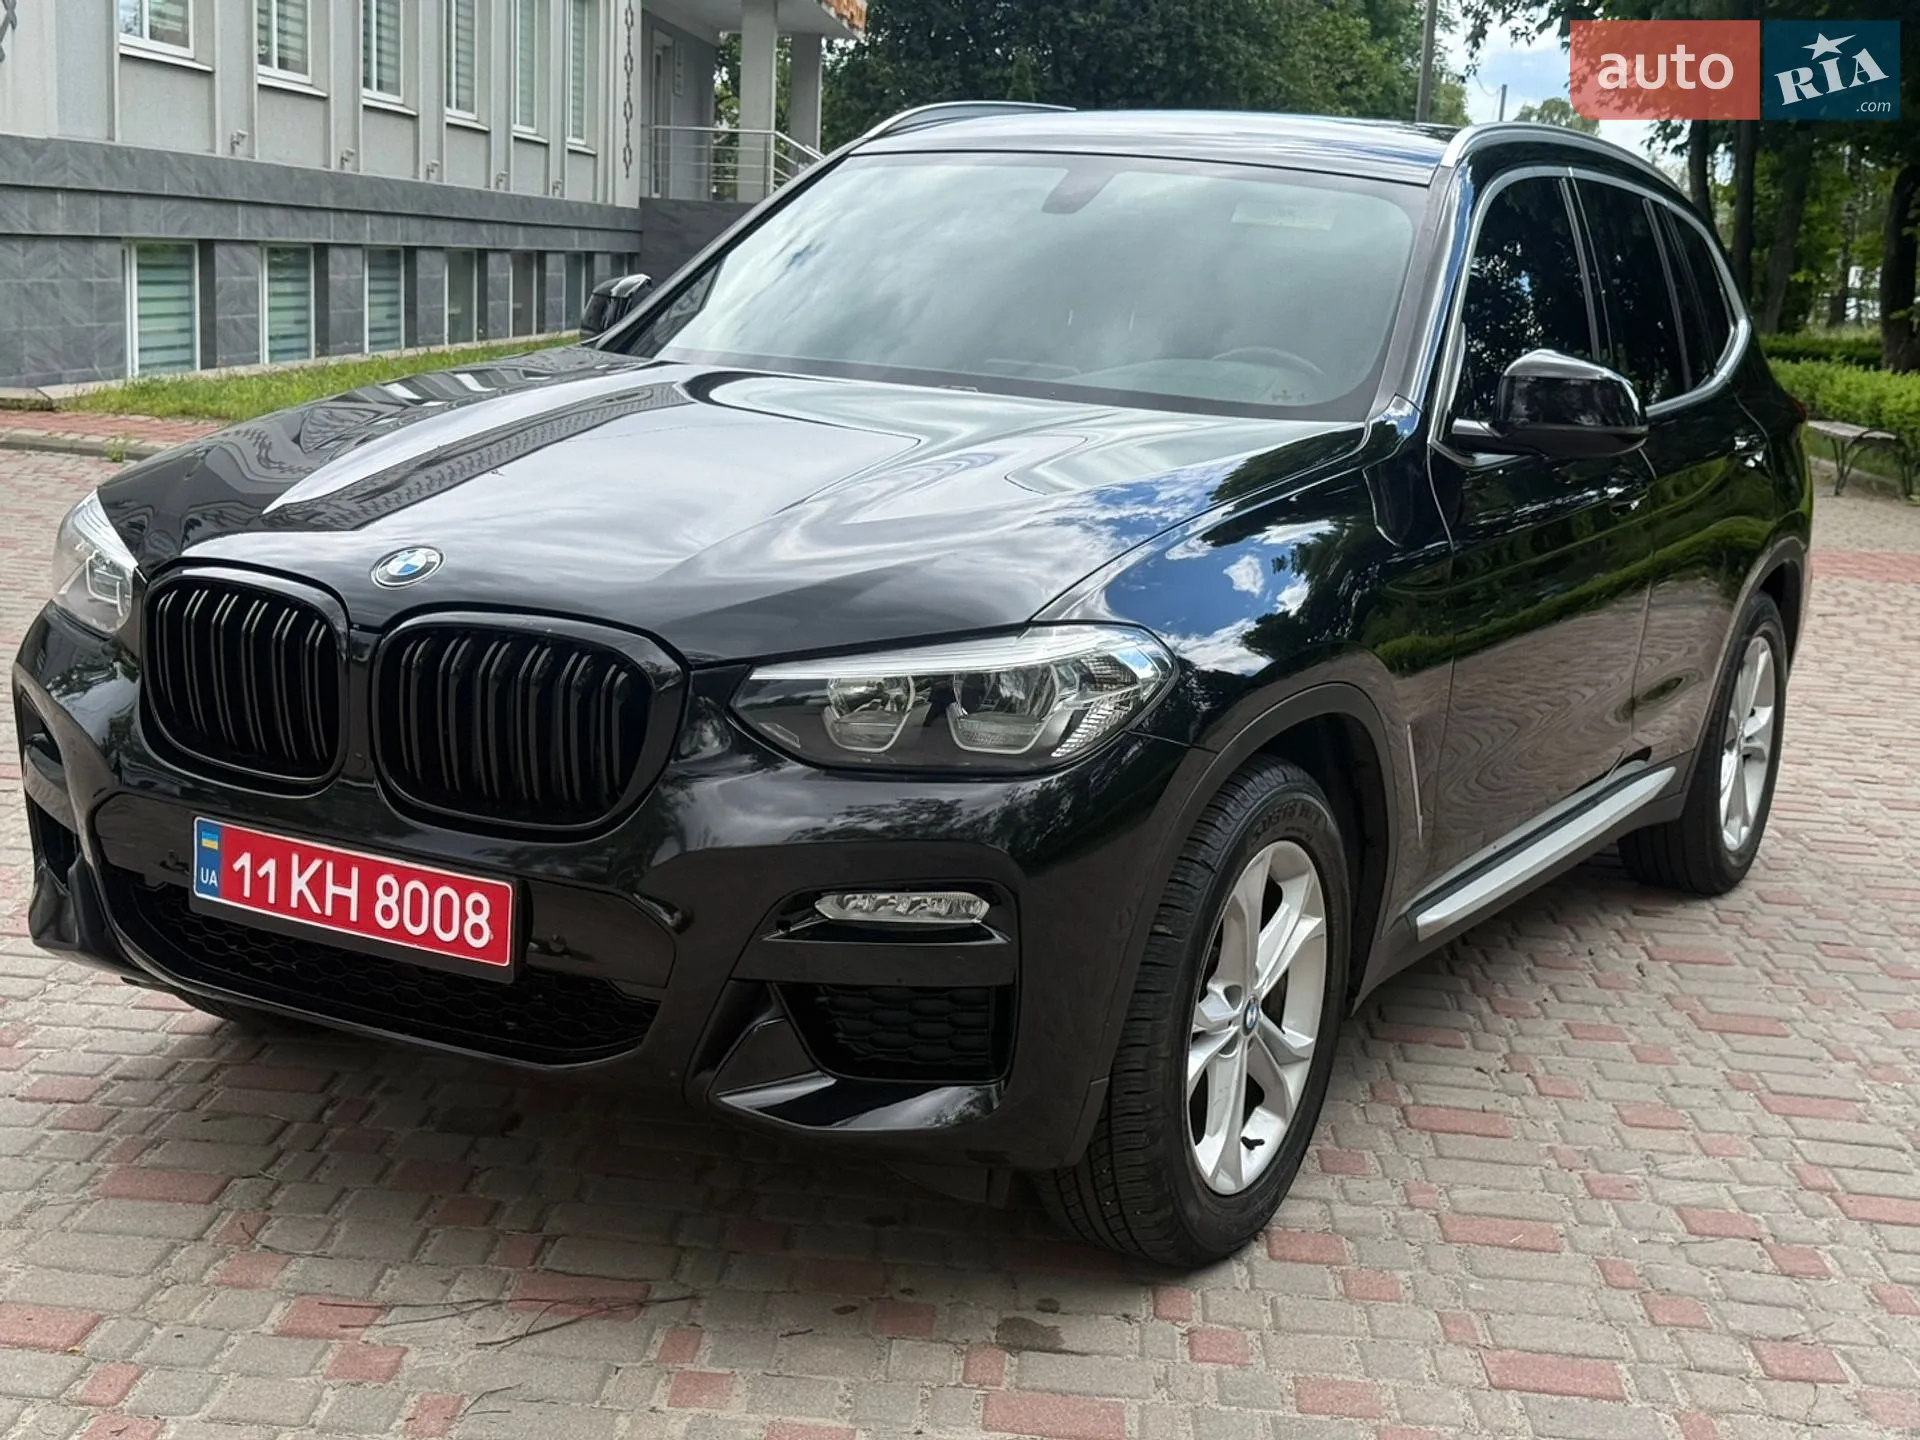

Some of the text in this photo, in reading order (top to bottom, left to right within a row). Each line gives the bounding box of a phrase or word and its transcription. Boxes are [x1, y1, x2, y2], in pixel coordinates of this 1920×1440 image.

[200, 867, 218, 887] UA
[232, 851, 492, 949] 11 KH 8008
